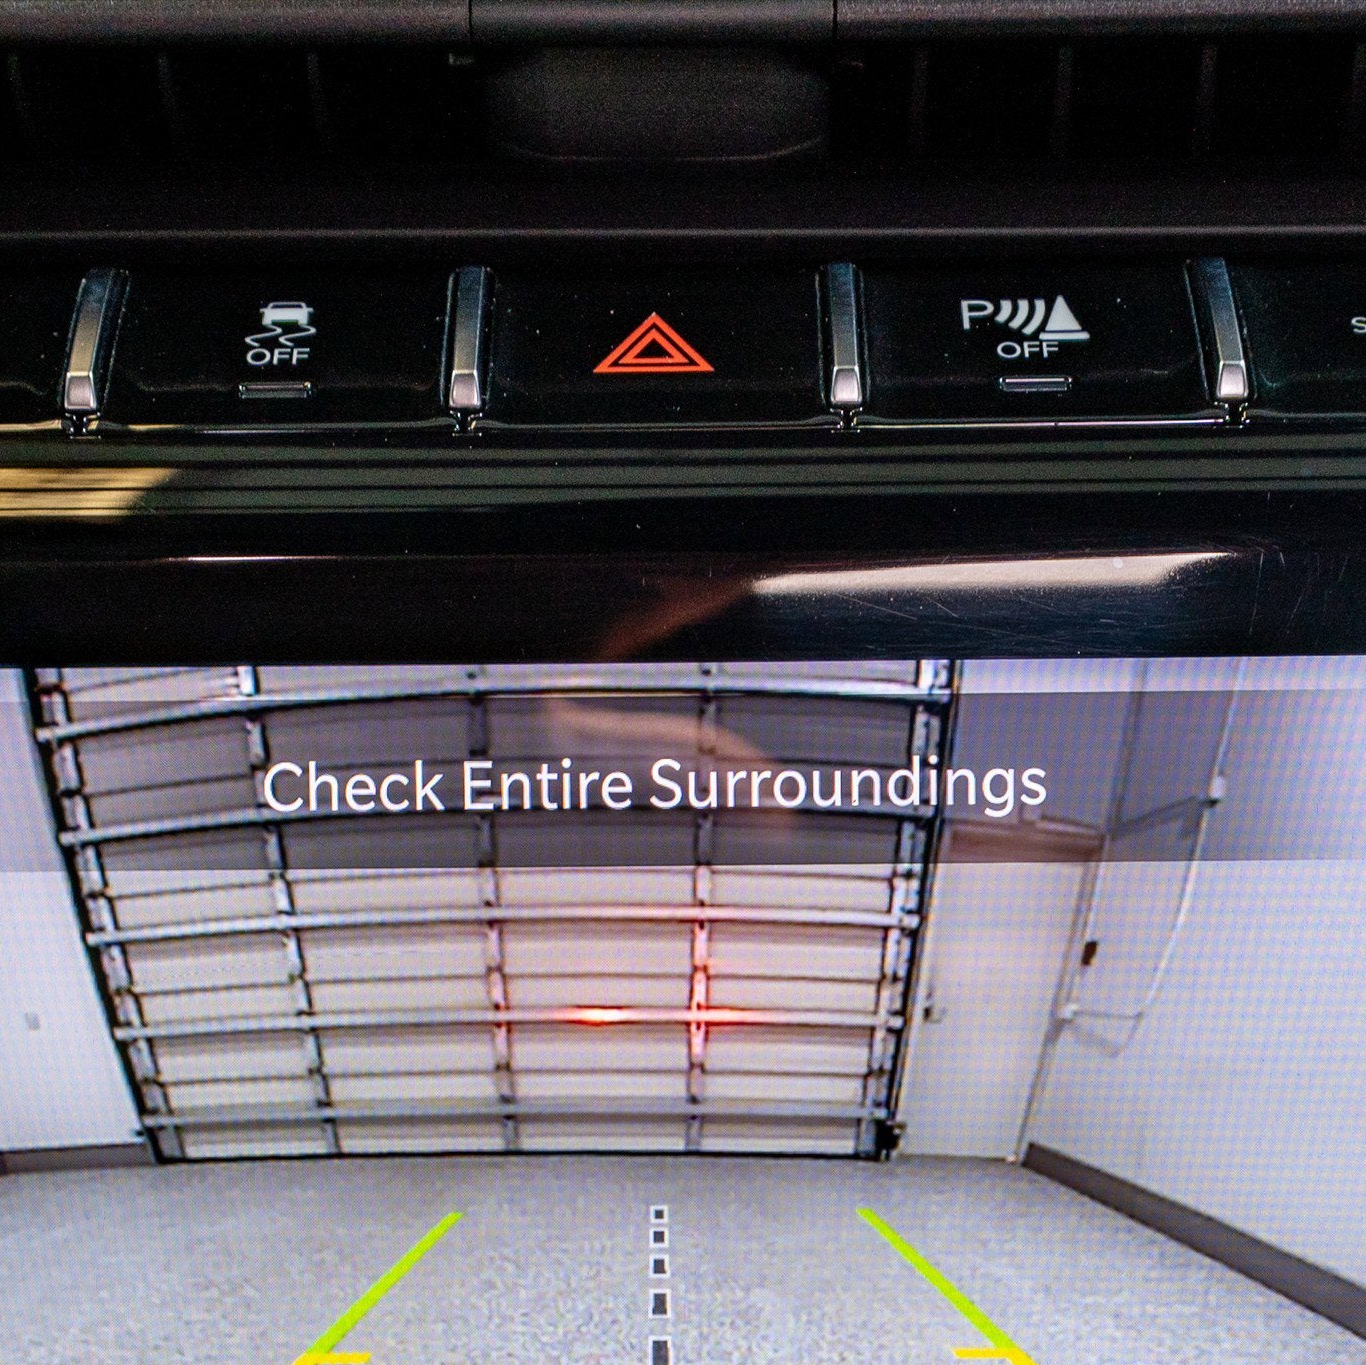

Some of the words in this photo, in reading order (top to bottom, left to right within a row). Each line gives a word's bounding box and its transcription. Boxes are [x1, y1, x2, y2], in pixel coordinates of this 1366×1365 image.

[245, 347, 311, 367] OFF
[996, 340, 1060, 359] OFF
[262, 759, 444, 812] Check
[463, 757, 633, 811] Entire
[649, 754, 1049, 818] Surroundings
